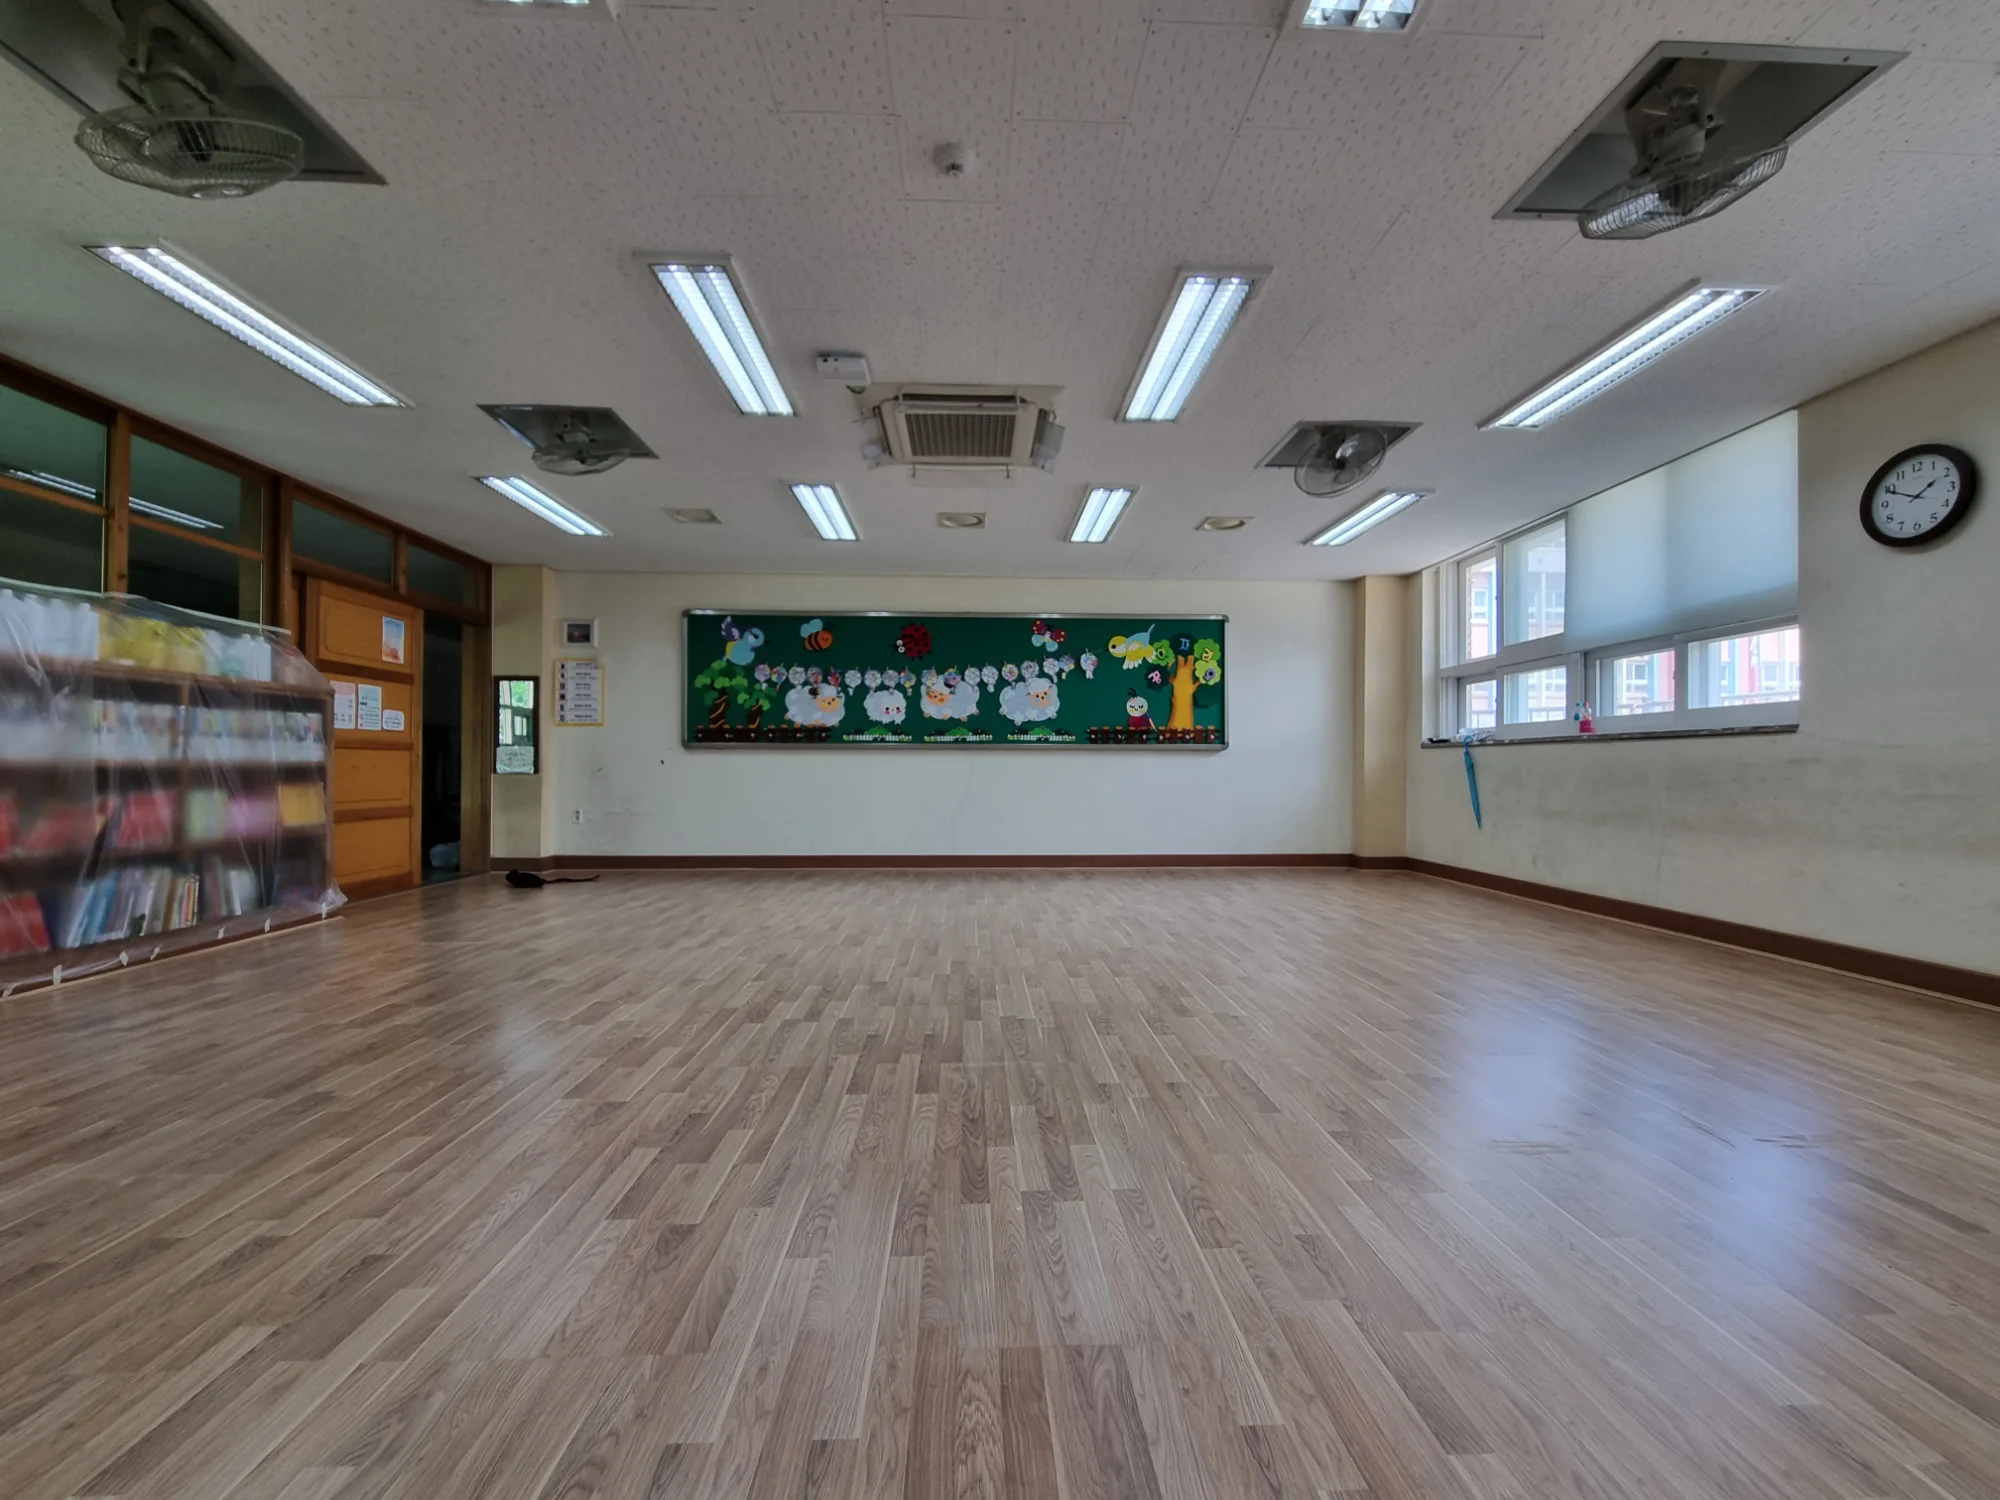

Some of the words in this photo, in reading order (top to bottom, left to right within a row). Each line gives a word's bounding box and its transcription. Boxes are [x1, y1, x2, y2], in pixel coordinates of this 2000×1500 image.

[1912, 461, 1923, 473] 12
[1931, 460, 1936, 471] 1
[1896, 470, 1905, 481] 11
[1943, 467, 1951, 478] 2
[1885, 483, 1896, 494] 10
[1947, 481, 1956, 492] 3
[1881, 500, 1889, 511] 9
[1941, 498, 1949, 508] 4
[1885, 513, 1894, 524] 8
[1930, 512, 1938, 524] 5
[1898, 521, 1905, 531] 7
[1913, 521, 1922, 531] 6
